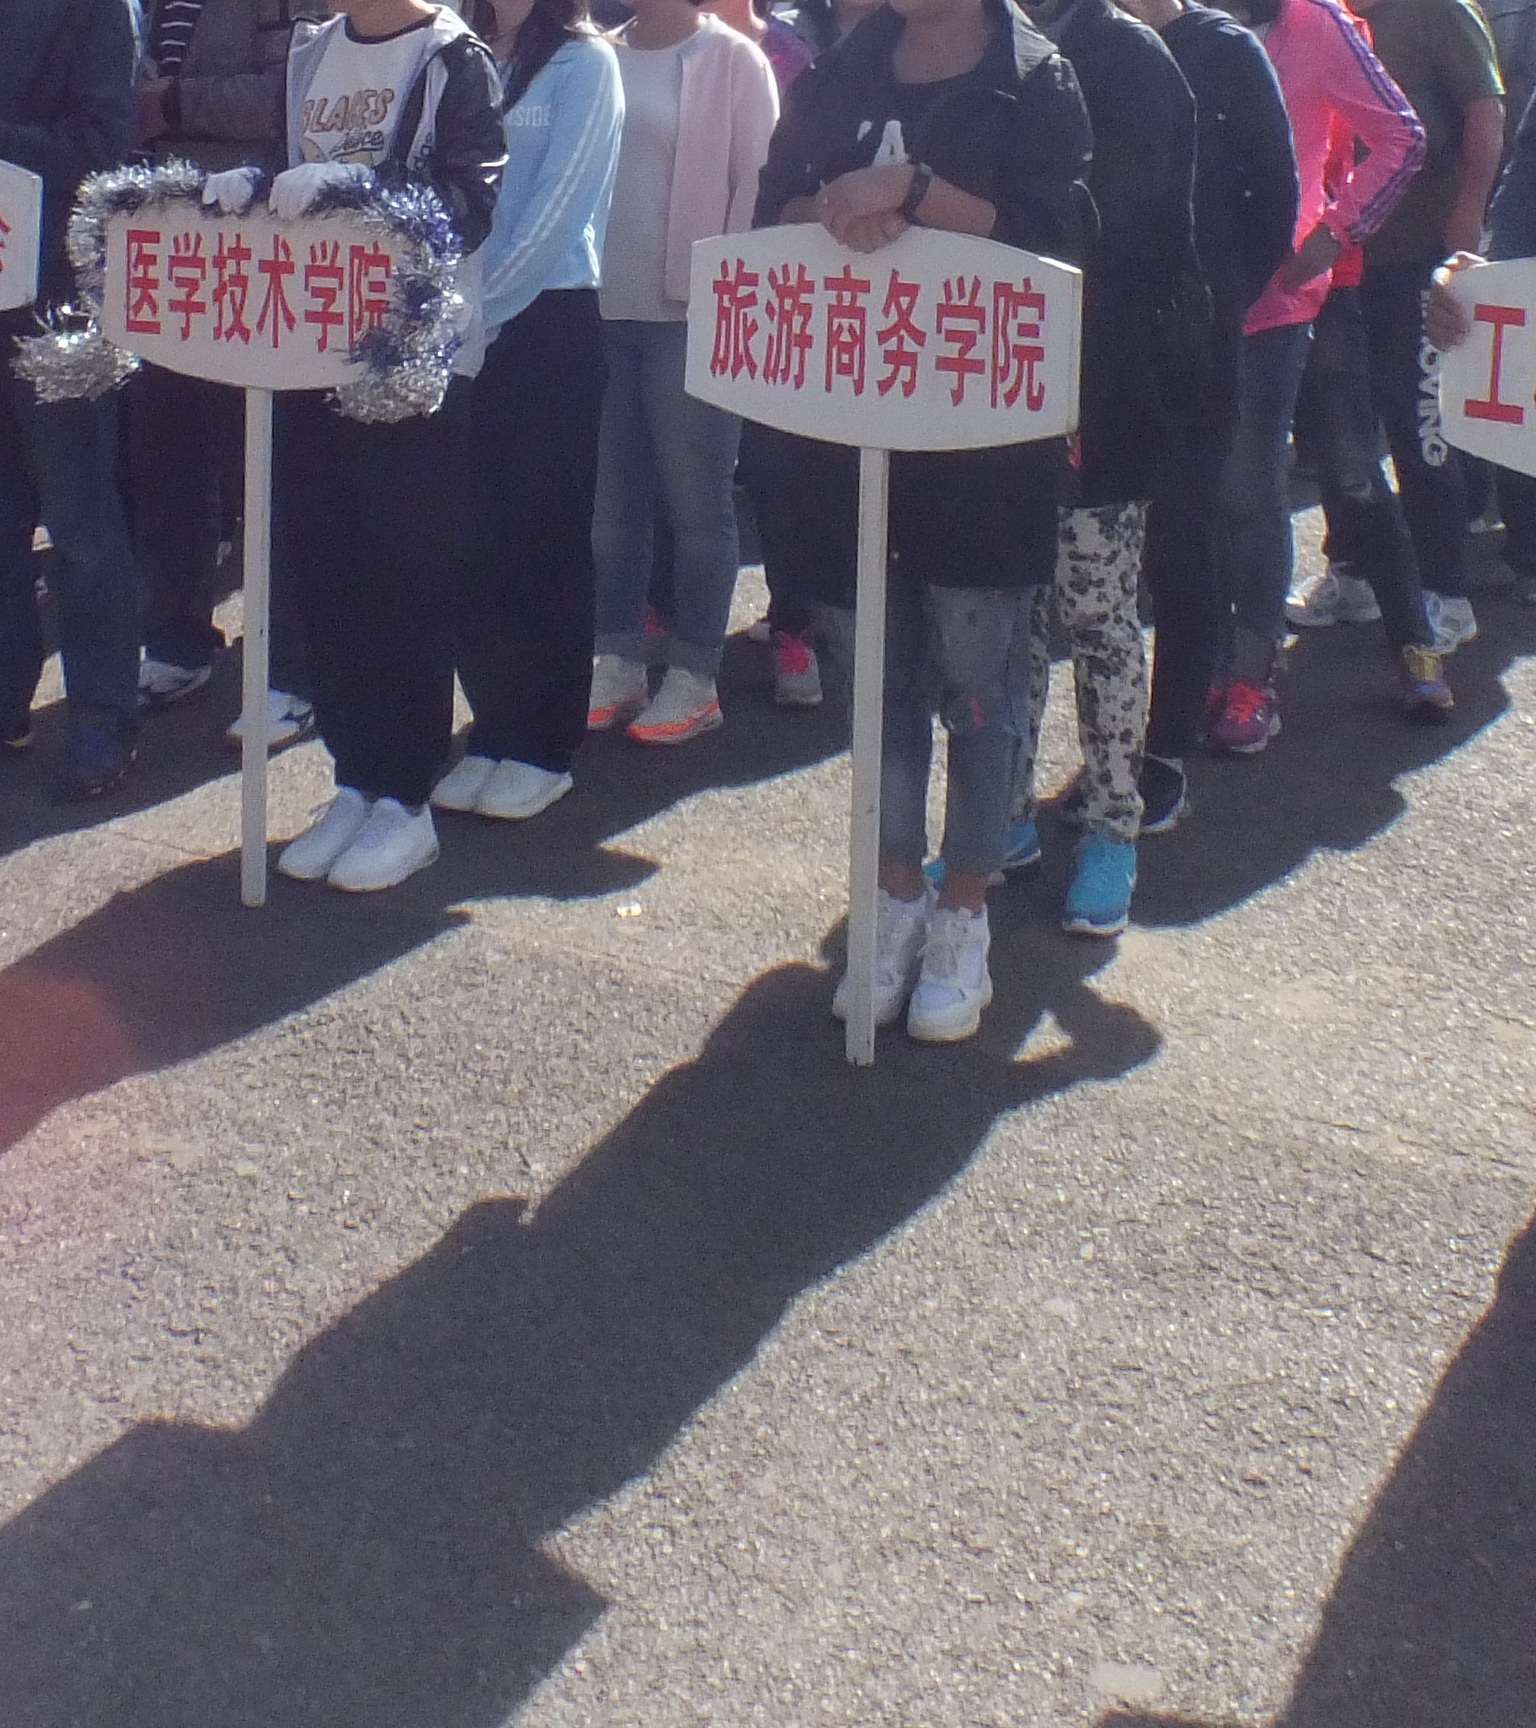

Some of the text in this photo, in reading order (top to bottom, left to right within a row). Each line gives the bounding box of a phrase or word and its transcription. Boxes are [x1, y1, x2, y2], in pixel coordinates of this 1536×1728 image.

[125, 229, 393, 353] 医学技术学院
[710, 257, 1046, 412] 旅游商务学院
